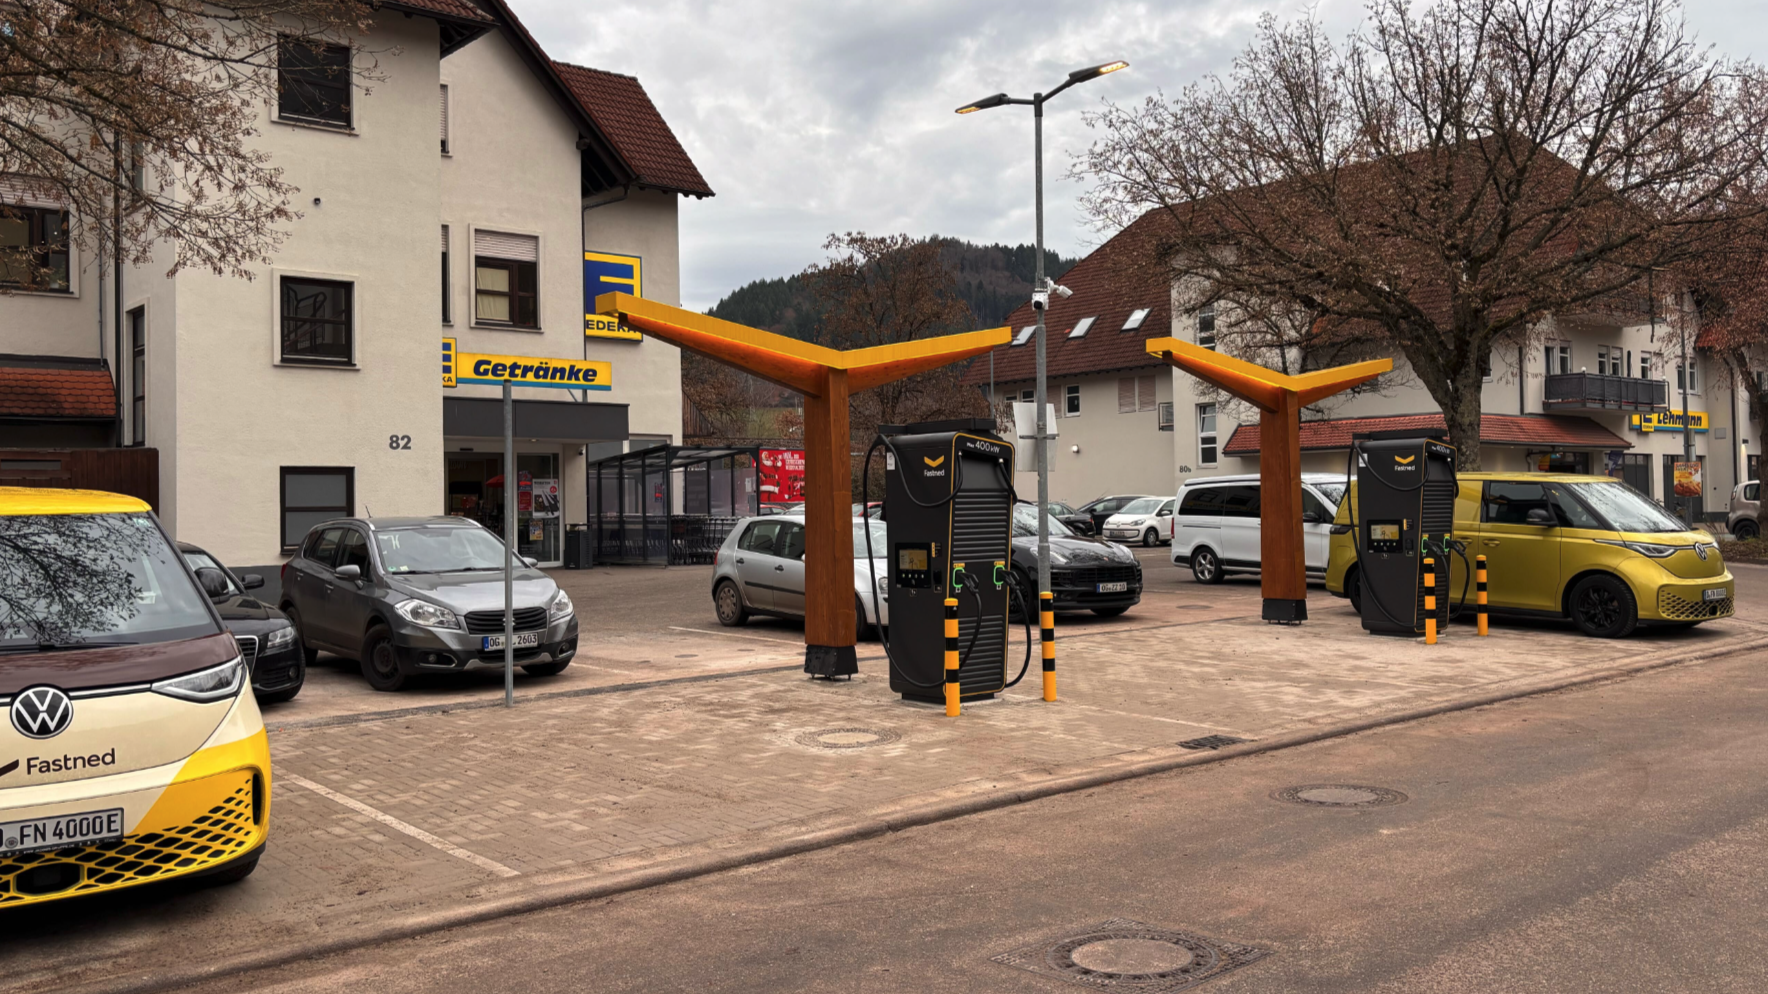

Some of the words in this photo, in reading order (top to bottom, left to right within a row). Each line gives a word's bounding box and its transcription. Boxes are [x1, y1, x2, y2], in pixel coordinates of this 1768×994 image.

[586, 319, 637, 333] EDEK
[473, 359, 598, 382] Getränke
[1657, 411, 1702, 427] Lehmnn
[389, 434, 411, 450] 82
[975, 440, 990, 451] 400
[924, 469, 945, 477] Fastned
[489, 637, 500, 647] OG
[517, 634, 537, 645] 2603
[27, 748, 116, 775] Fastned
[20, 822, 46, 845] FN
[52, 812, 119, 840] 4000E
